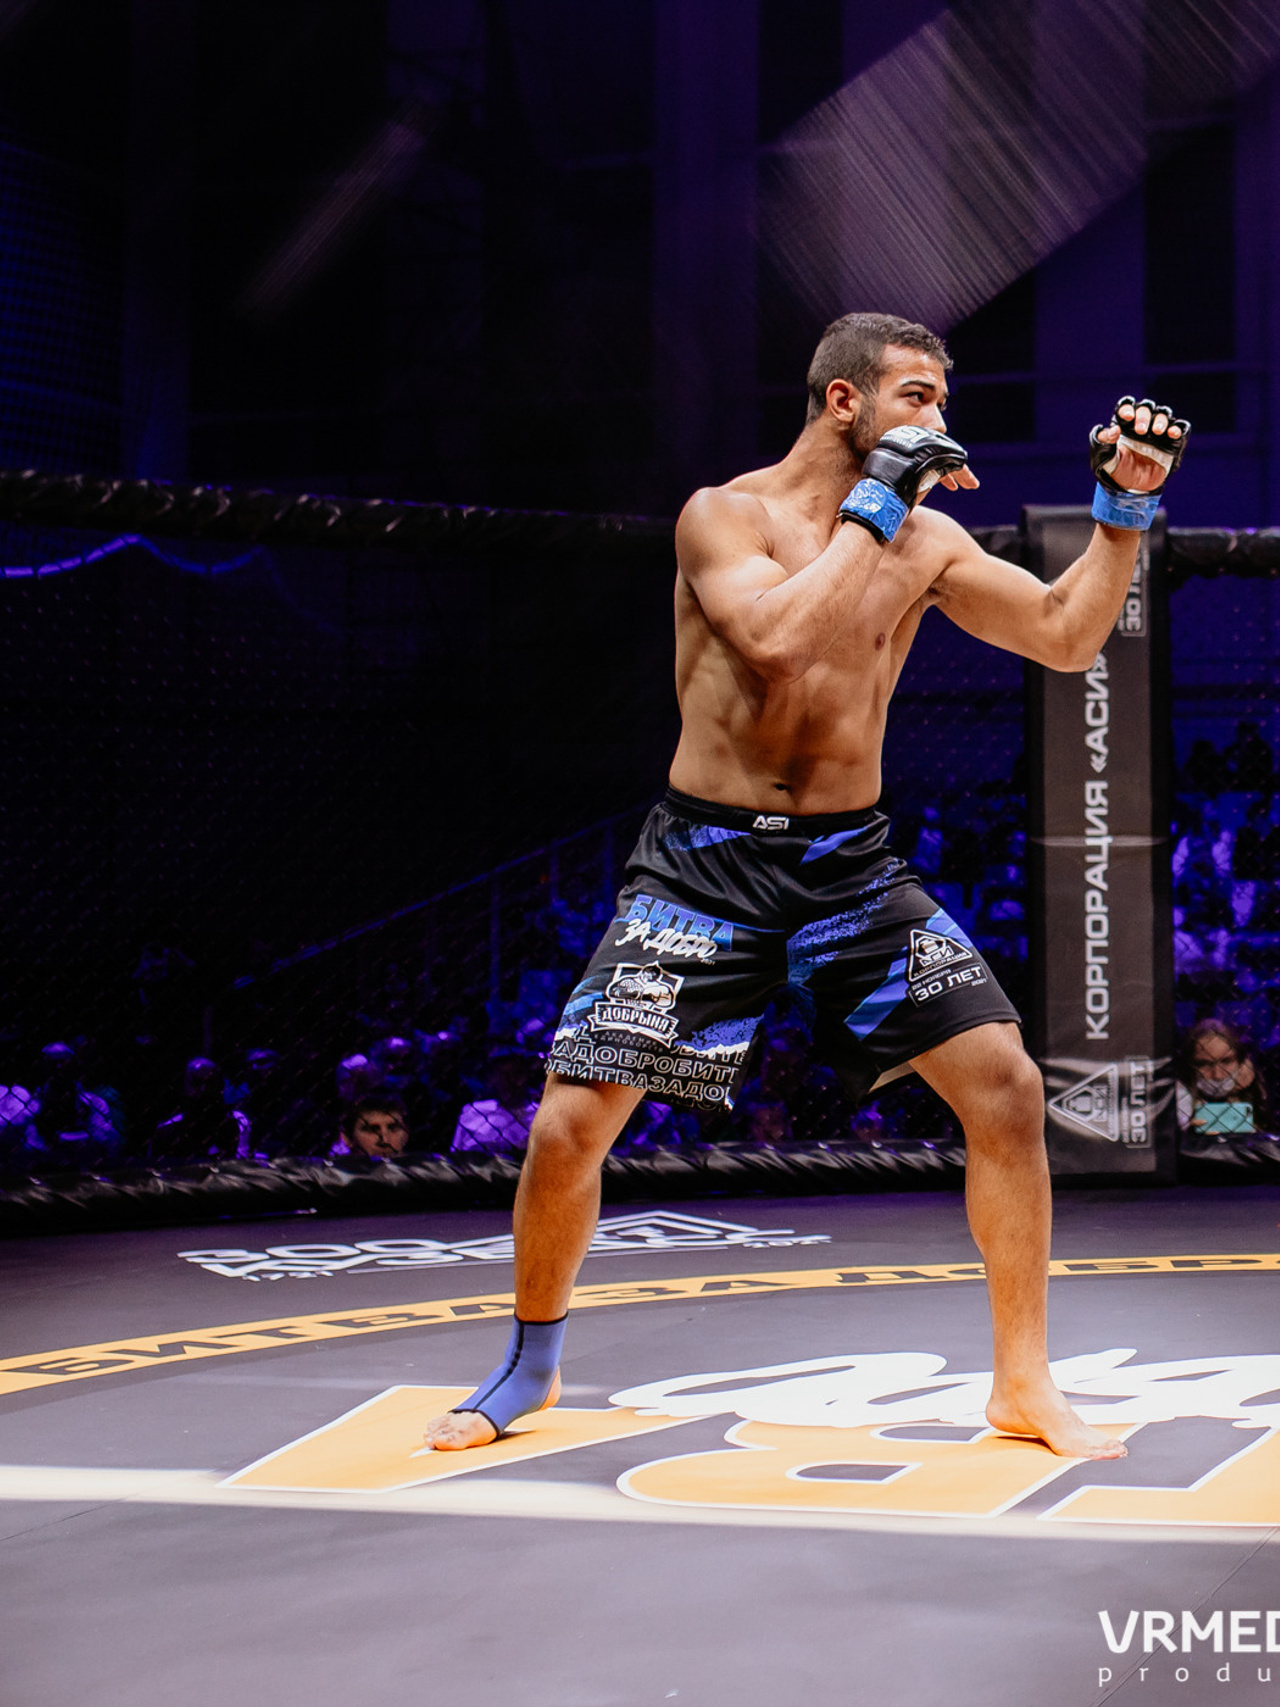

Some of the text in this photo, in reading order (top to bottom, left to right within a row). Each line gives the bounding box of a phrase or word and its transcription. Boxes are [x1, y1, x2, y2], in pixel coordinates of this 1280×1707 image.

[1125, 598, 1141, 631] 30
[752, 815, 790, 830] ASI
[624, 893, 734, 951] БИТВА
[1084, 780, 1113, 1040] КОРПОРАЦИЯ
[615, 918, 718, 958] ЗА ДОБРО
[914, 981, 943, 1001] 30
[946, 965, 981, 988] ЛЕТ
[601, 1006, 671, 1033] ДОБРЫНЯ
[1130, 1061, 1147, 1143] 30 ЛЕТ
[176, 1238, 450, 1264] 300
[2, 1303, 515, 1375] БИТВА
[570, 1279, 790, 1300] ЗА
